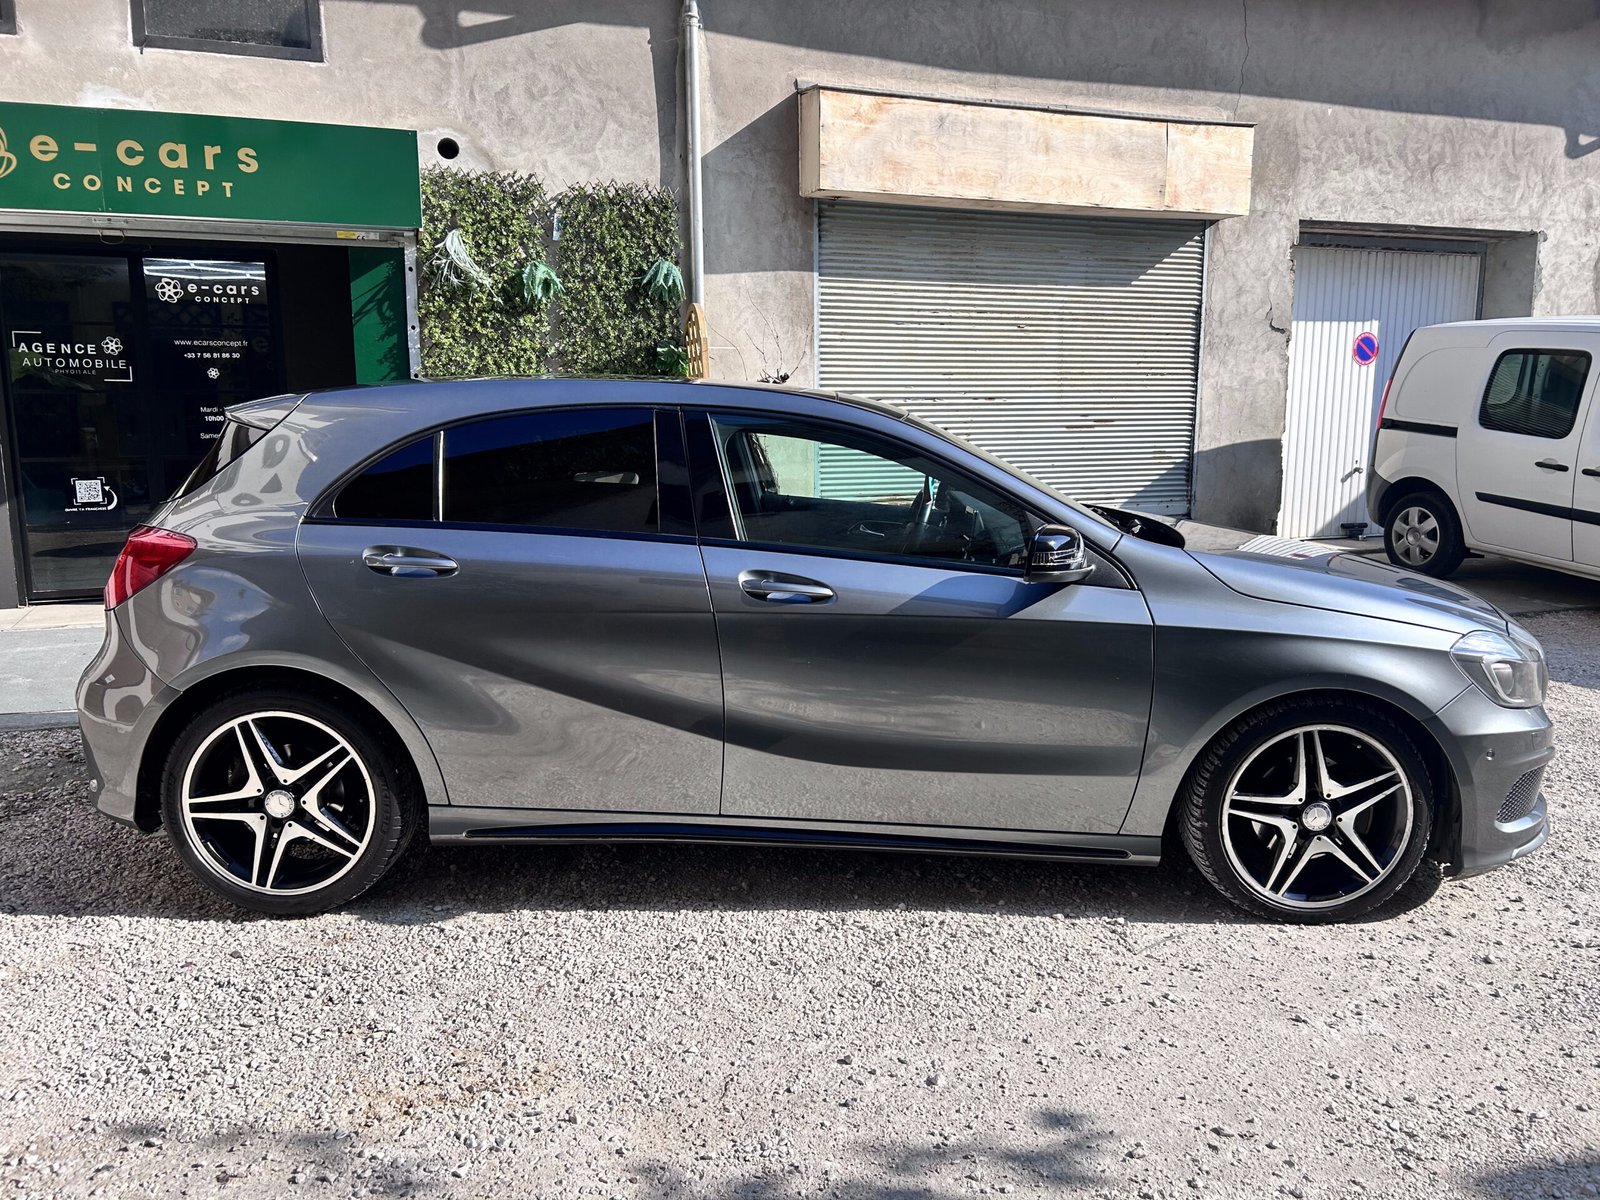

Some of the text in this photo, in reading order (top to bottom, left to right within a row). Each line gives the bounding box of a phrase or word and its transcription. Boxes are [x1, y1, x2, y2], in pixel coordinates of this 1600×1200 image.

[29, 134, 260, 174] e-cars
[52, 172, 234, 198] CONCEPT
[187, 283, 260, 296] e-cars
[194, 295, 250, 304] CONCEPT
[18, 342, 97, 355] AGENCE
[173, 339, 249, 348] www.ecarsconcept.fr
[22, 357, 127, 369] AUTOMOBILE
